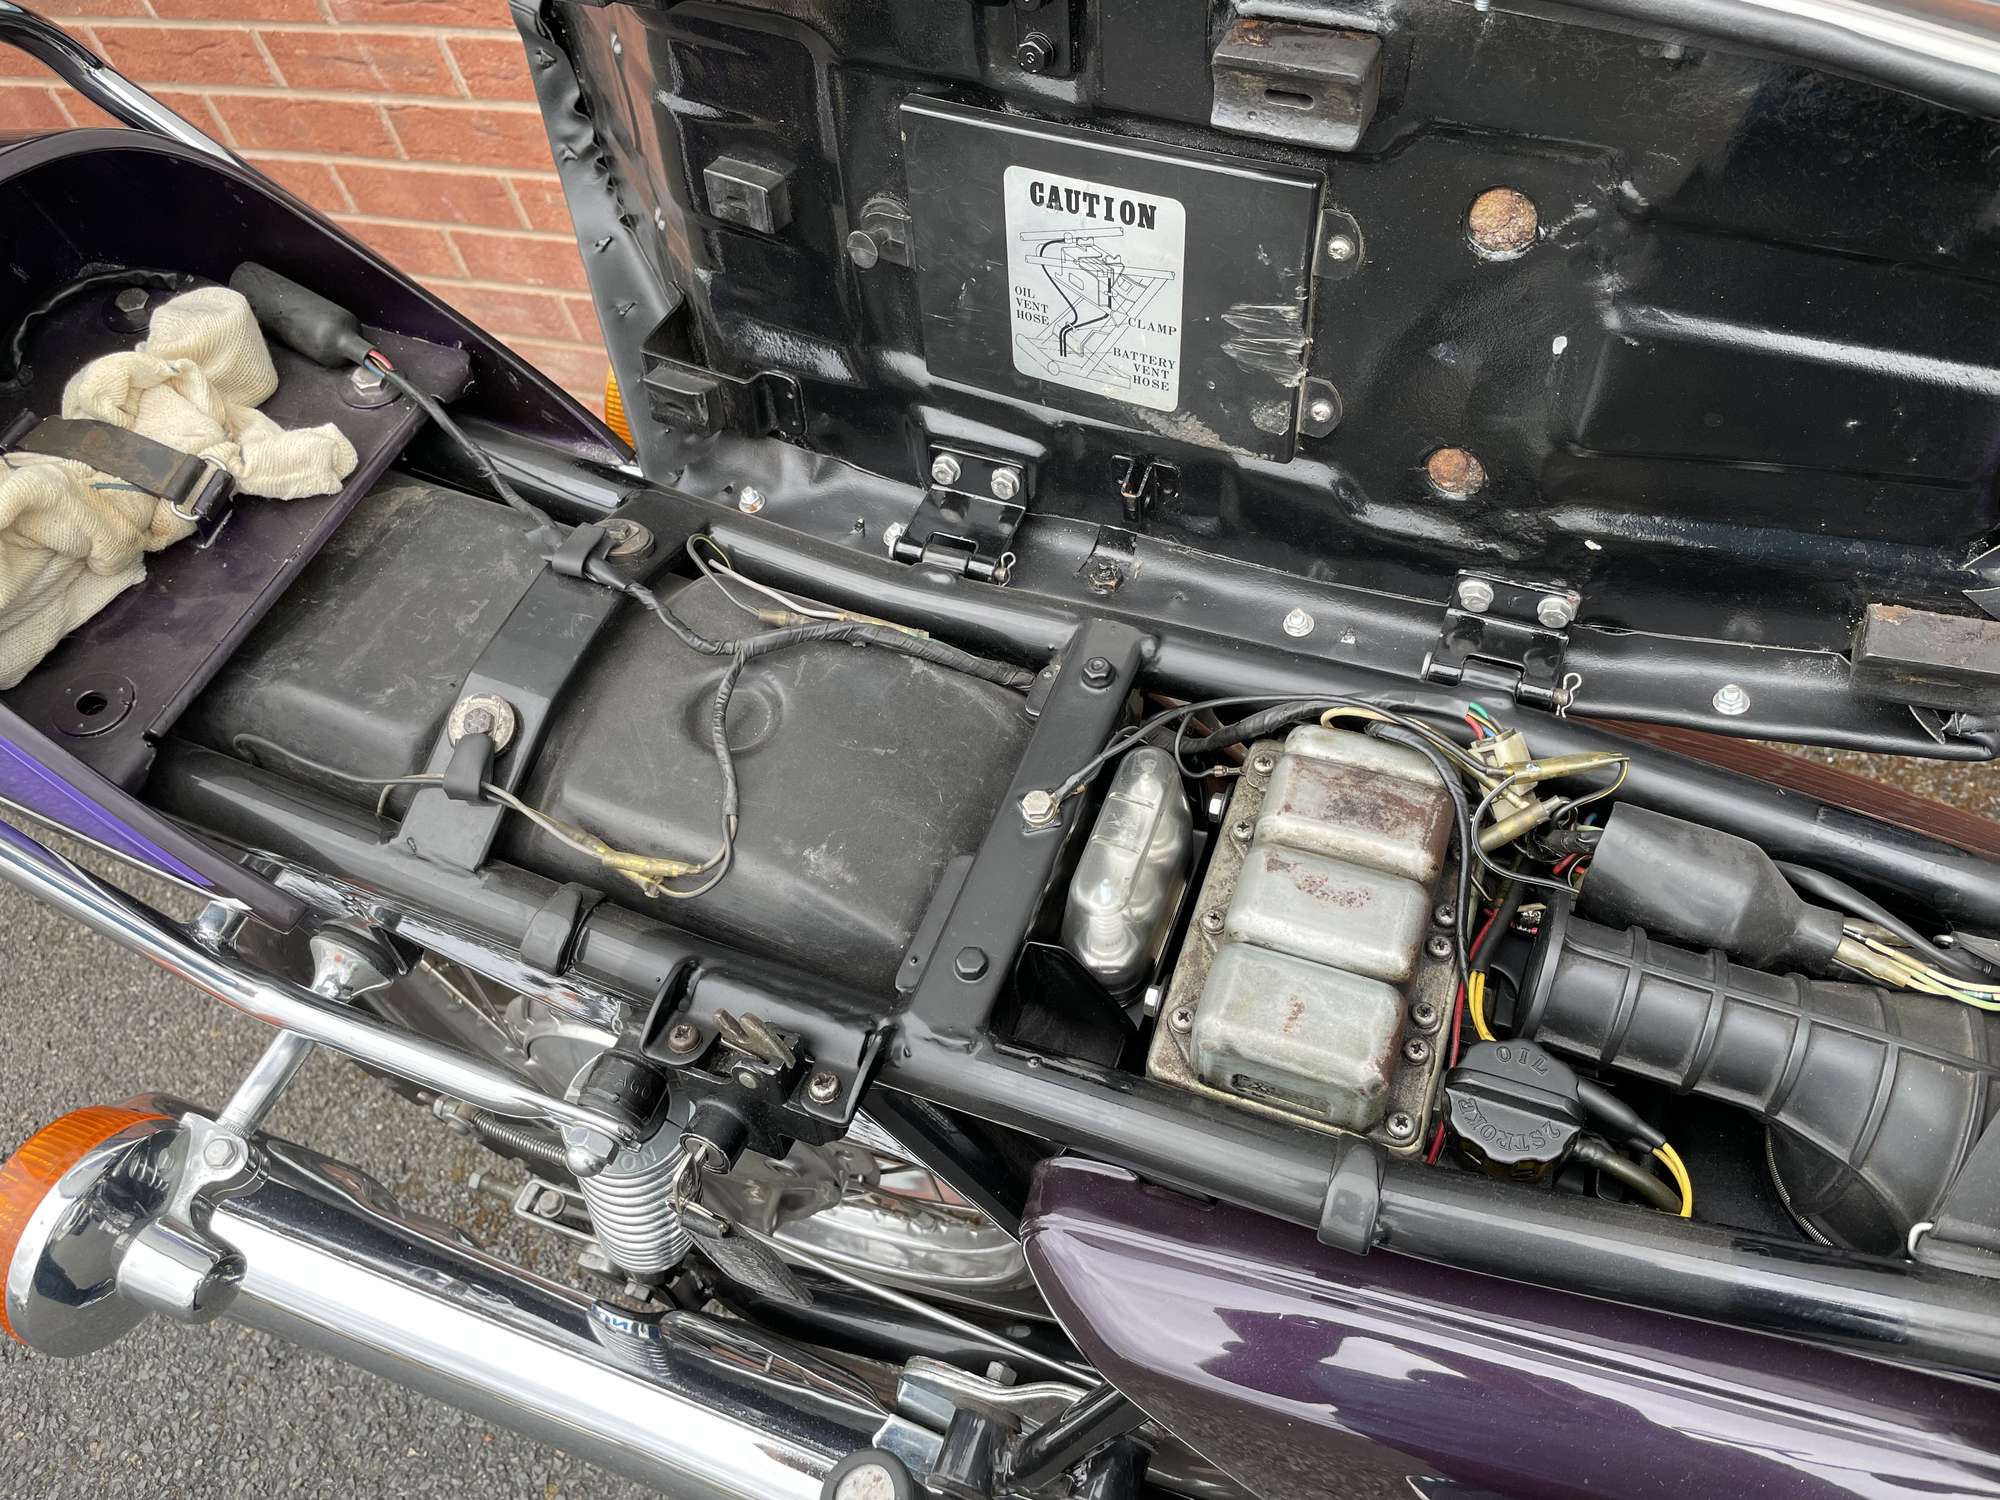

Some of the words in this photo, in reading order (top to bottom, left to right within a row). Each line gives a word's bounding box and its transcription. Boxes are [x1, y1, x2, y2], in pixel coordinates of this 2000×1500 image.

[1029, 181, 1156, 230] CAUTION
[1014, 285, 1035, 299] OIL
[1016, 297, 1049, 314] VENT
[1016, 309, 1050, 326] HOSE
[1128, 318, 1177, 336] CLAMP
[1113, 347, 1176, 370] BATTERY
[1133, 363, 1170, 379] VENT
[1132, 374, 1170, 392] HOSE
[1496, 1046, 1549, 1075] OIL
